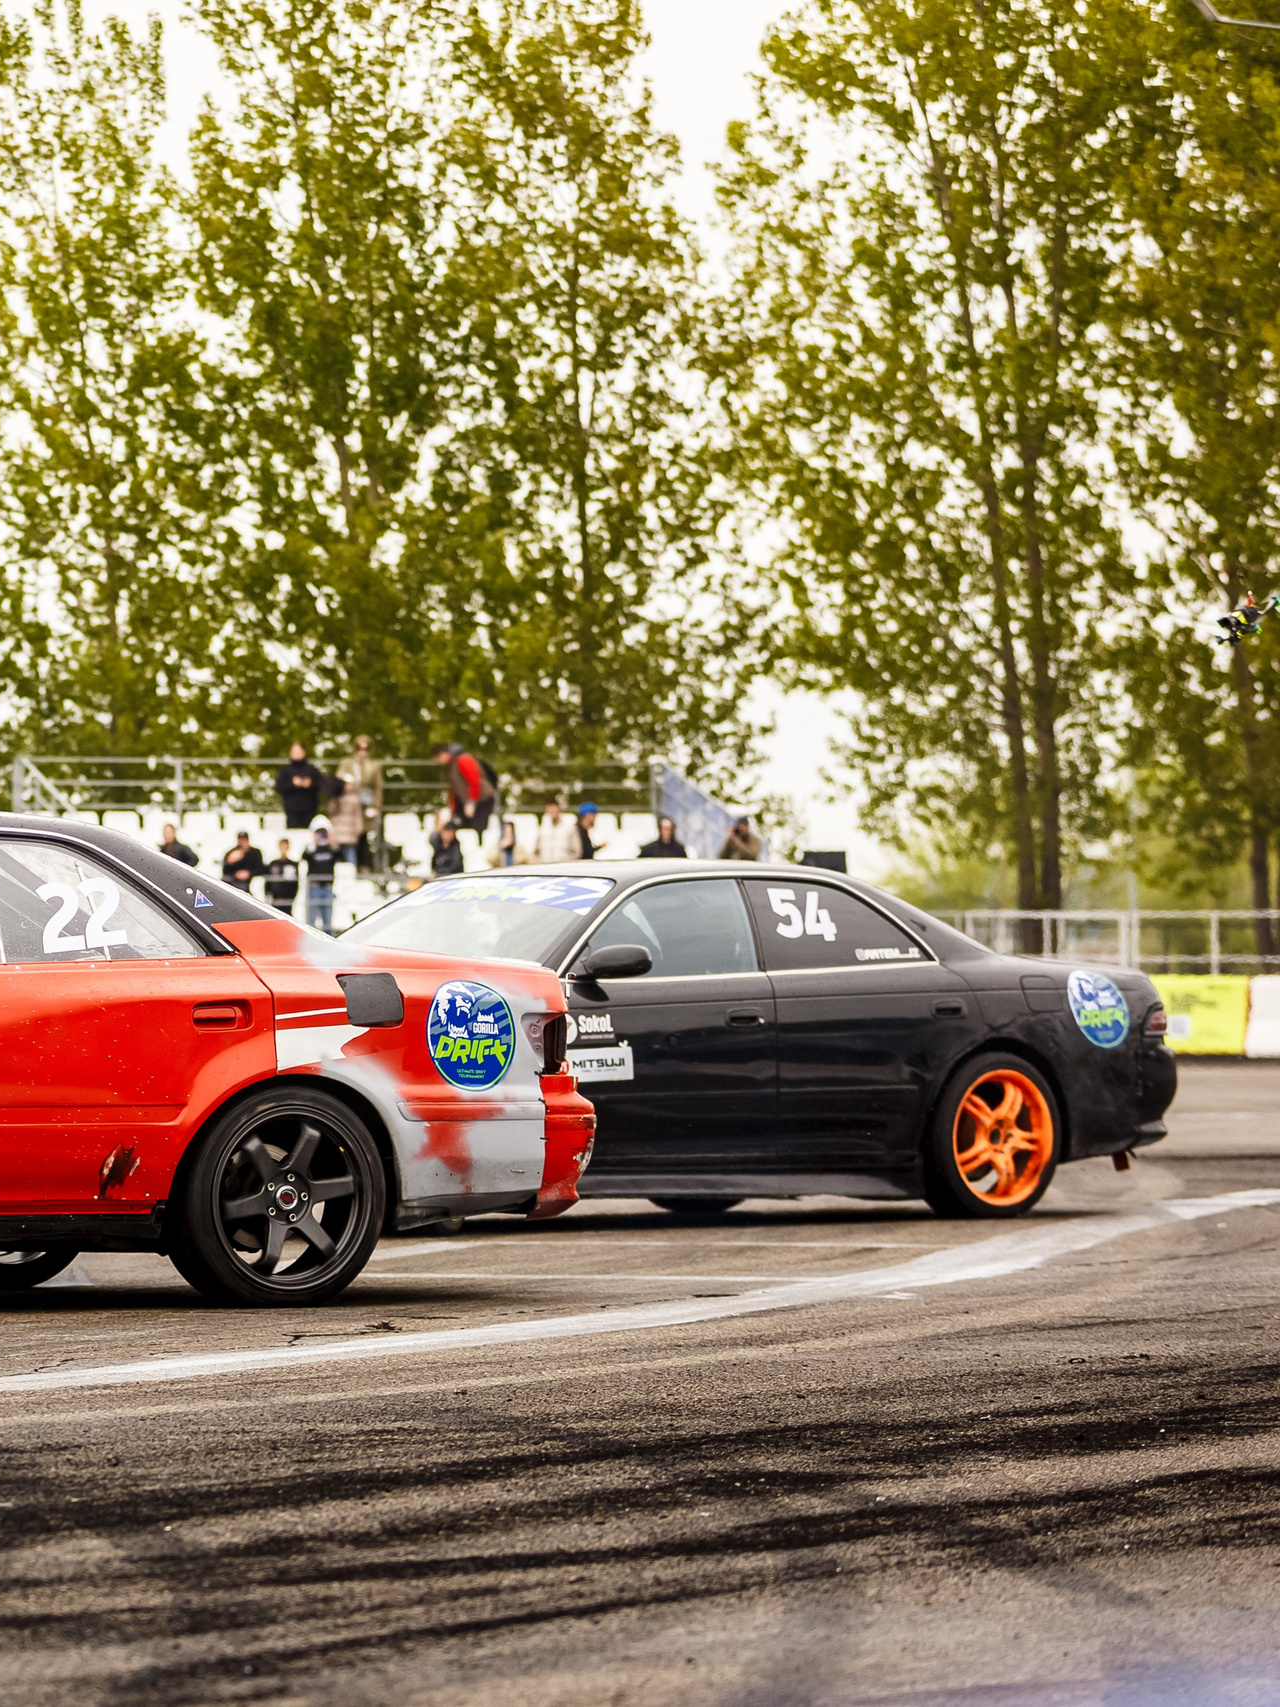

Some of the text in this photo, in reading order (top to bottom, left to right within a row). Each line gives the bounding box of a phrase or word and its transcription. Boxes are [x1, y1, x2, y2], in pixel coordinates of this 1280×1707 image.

[35, 877, 128, 954] 22
[766, 888, 838, 942] 54
[473, 1022, 499, 1035] GORILLA
[434, 1034, 508, 1067] DRIFT
[572, 1057, 626, 1069] MITSUJI
